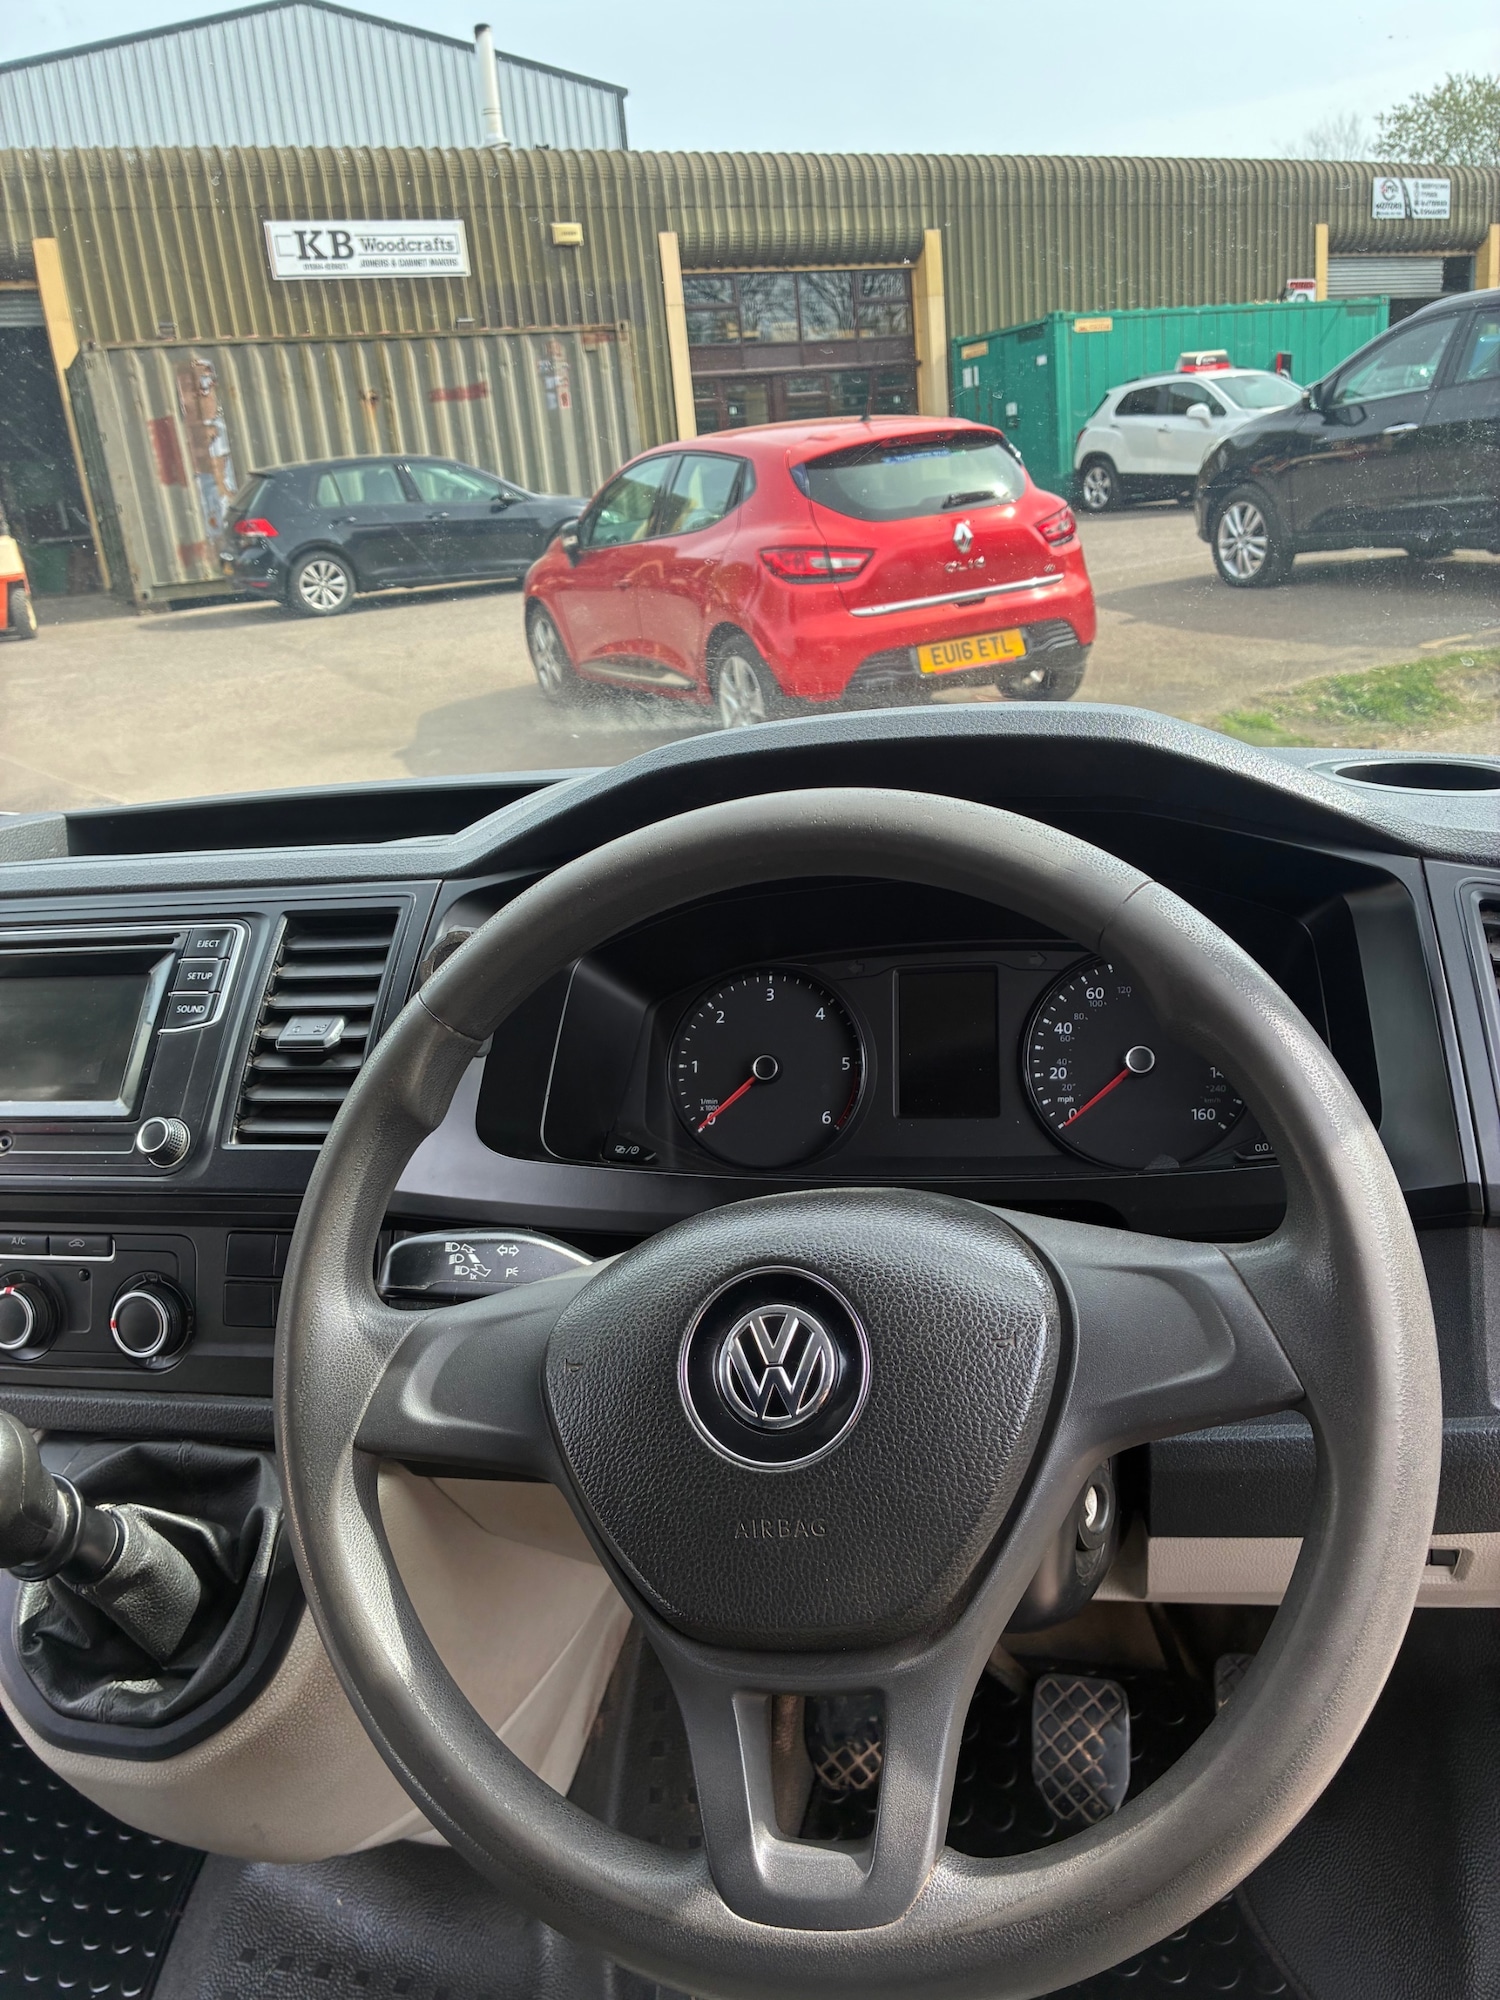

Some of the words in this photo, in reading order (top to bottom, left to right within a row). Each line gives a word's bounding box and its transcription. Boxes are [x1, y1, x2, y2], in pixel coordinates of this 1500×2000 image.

[294, 230, 354, 260] KB
[359, 237, 454, 253] Woodcrafts
[930, 641, 973, 666] EU16
[977, 635, 1014, 657] ETL
[197, 940, 220, 948] EJECT
[187, 972, 213, 980] SETUP
[766, 989, 775, 1001] 3
[1086, 987, 1105, 1000] 60
[1117, 986, 1132, 994] 120
[176, 1005, 205, 1013] SOUND
[1089, 1000, 1104, 1008] 100
[716, 1011, 725, 1024] 2
[815, 1007, 826, 1020] 4
[1074, 1013, 1085, 1021] 80
[1054, 1022, 1073, 1035] 40
[1060, 1034, 1071, 1042] 60
[691, 1060, 699, 1073] 1
[842, 1057, 851, 1070] 5
[1056, 1058, 1068, 1066] 40
[1049, 1066, 1067, 1079] 20
[1062, 1083, 1073, 1091] 20
[1210, 1085, 1227, 1093] 240
[1057, 1094, 1074, 1104] mph
[707, 1112, 716, 1125] 0
[821, 1111, 831, 1124] 6
[1191, 1108, 1216, 1120] 160
[11, 1237, 26, 1245] A/C
[735, 1518, 827, 1538] AIRBAG
